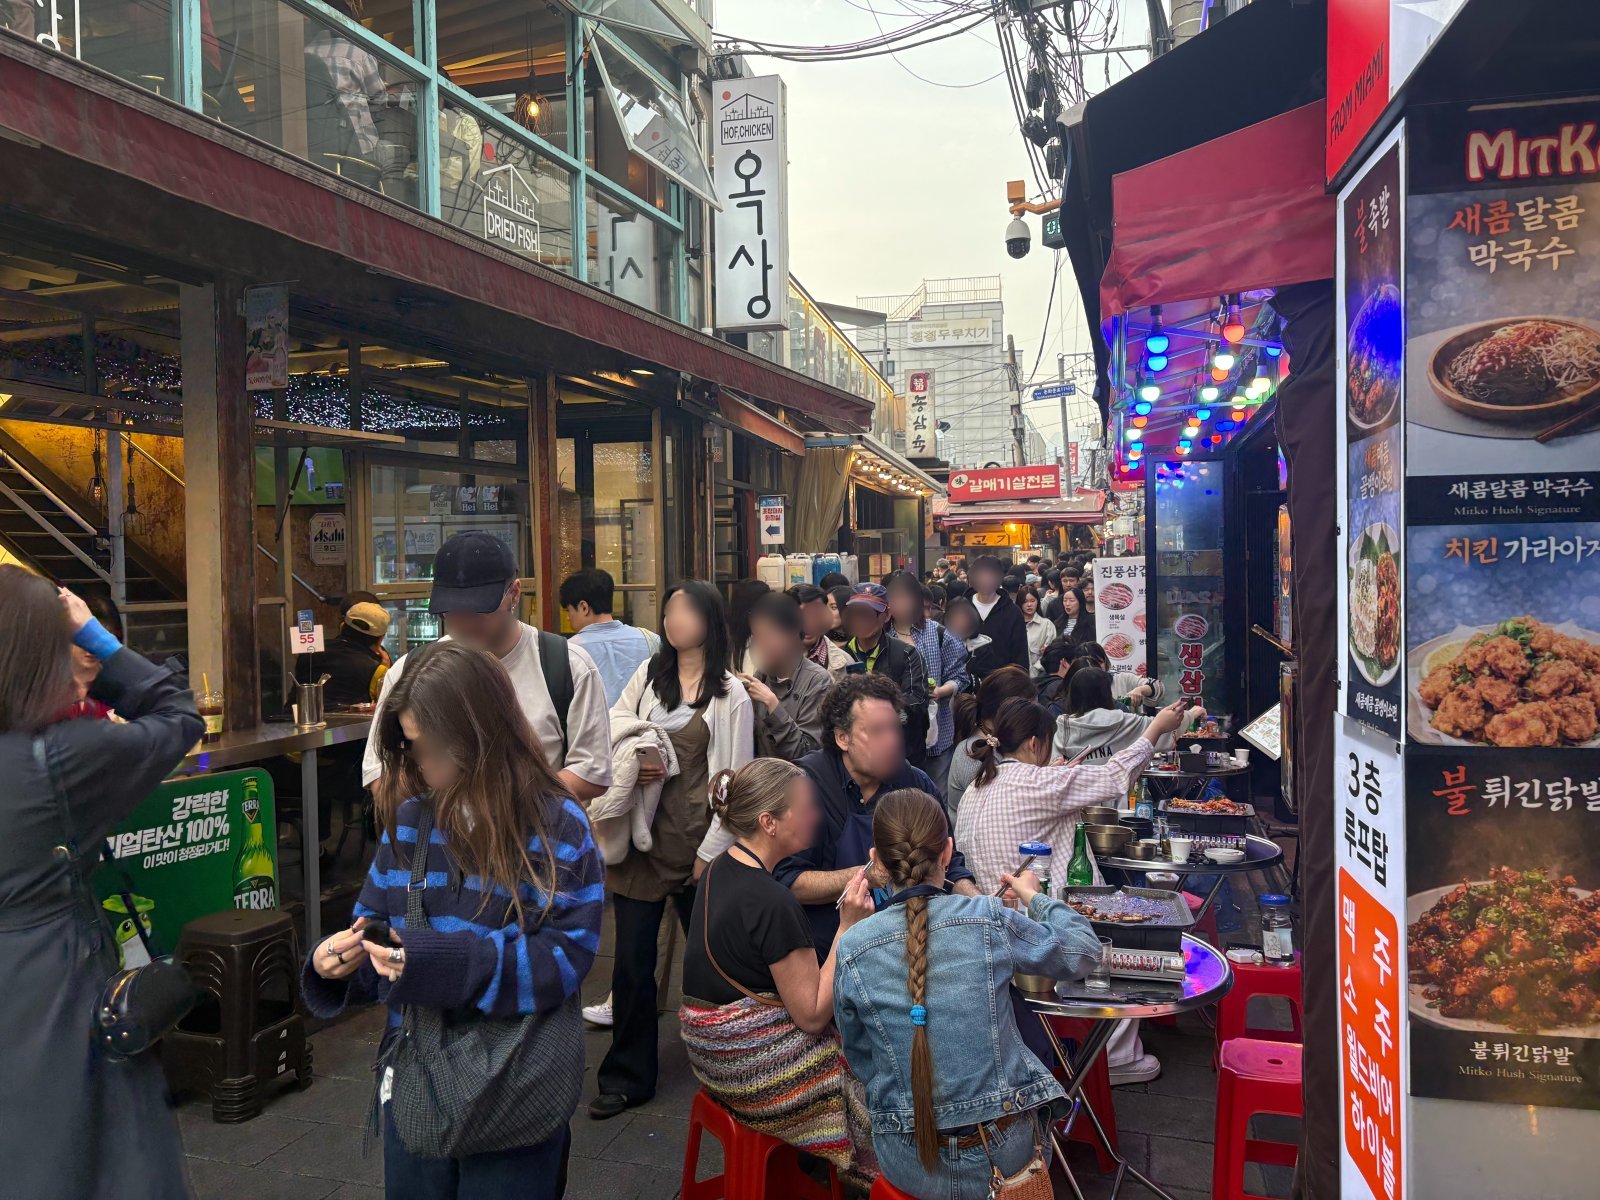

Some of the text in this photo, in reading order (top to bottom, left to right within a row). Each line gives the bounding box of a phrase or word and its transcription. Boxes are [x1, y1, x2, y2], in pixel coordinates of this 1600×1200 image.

[1330, 41, 1385, 148] FROM MIAMI
[1466, 121, 1600, 183] MITK
[1443, 194, 1586, 237] 새콤달콤
[487, 210, 538, 254] DRIED FISH
[728, 149, 774, 320] 옥상
[1467, 236, 1576, 275] 막국수
[968, 474, 1056, 493] 갈매기살전문
[1447, 478, 1594, 501] 새콤달콤 막국수
[1453, 505, 1582, 517] Mitko Hush Signature
[313, 528, 345, 543] Asahi
[1443, 536, 1499, 567] 치킨
[299, 633, 315, 644] 55
[172, 788, 230, 821] 강력한
[1432, 765, 1479, 816] 불
[186, 813, 230, 843] 100%
[1344, 806, 1388, 888] 루프탑
[1468, 1040, 1575, 1067] 불튀긴닭발
[1458, 1065, 1584, 1084] Mitko Hush Signature
